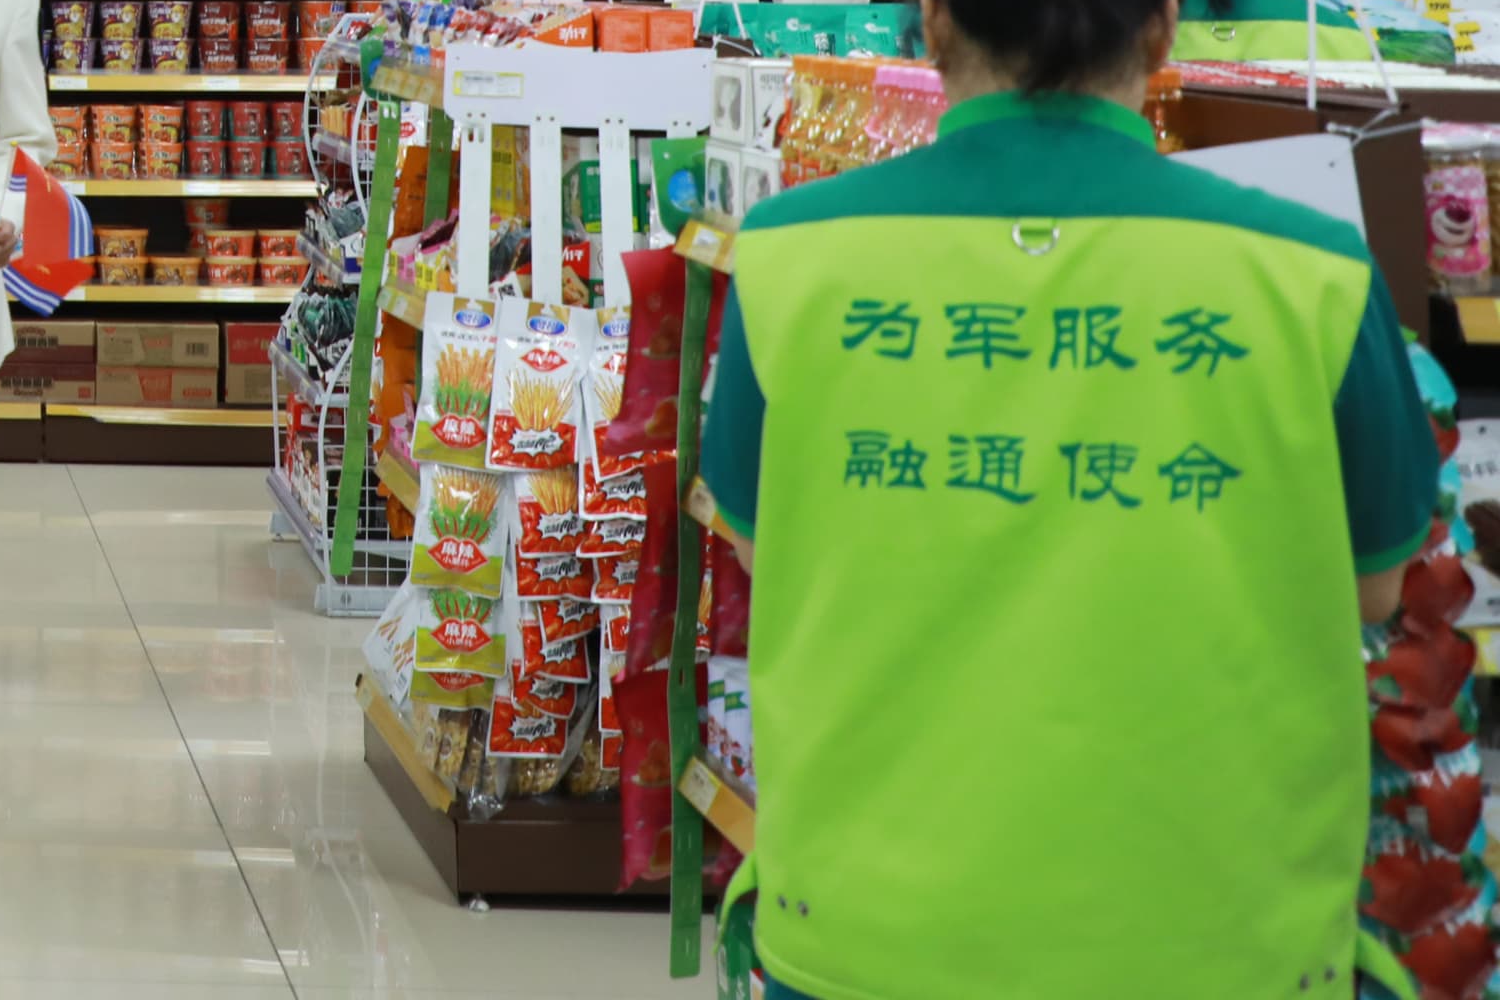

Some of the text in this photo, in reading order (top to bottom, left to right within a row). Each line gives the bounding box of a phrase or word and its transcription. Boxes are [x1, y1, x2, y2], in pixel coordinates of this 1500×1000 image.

[841, 299, 1250, 377] 为军服务
[843, 430, 1243, 513] 融通使命
